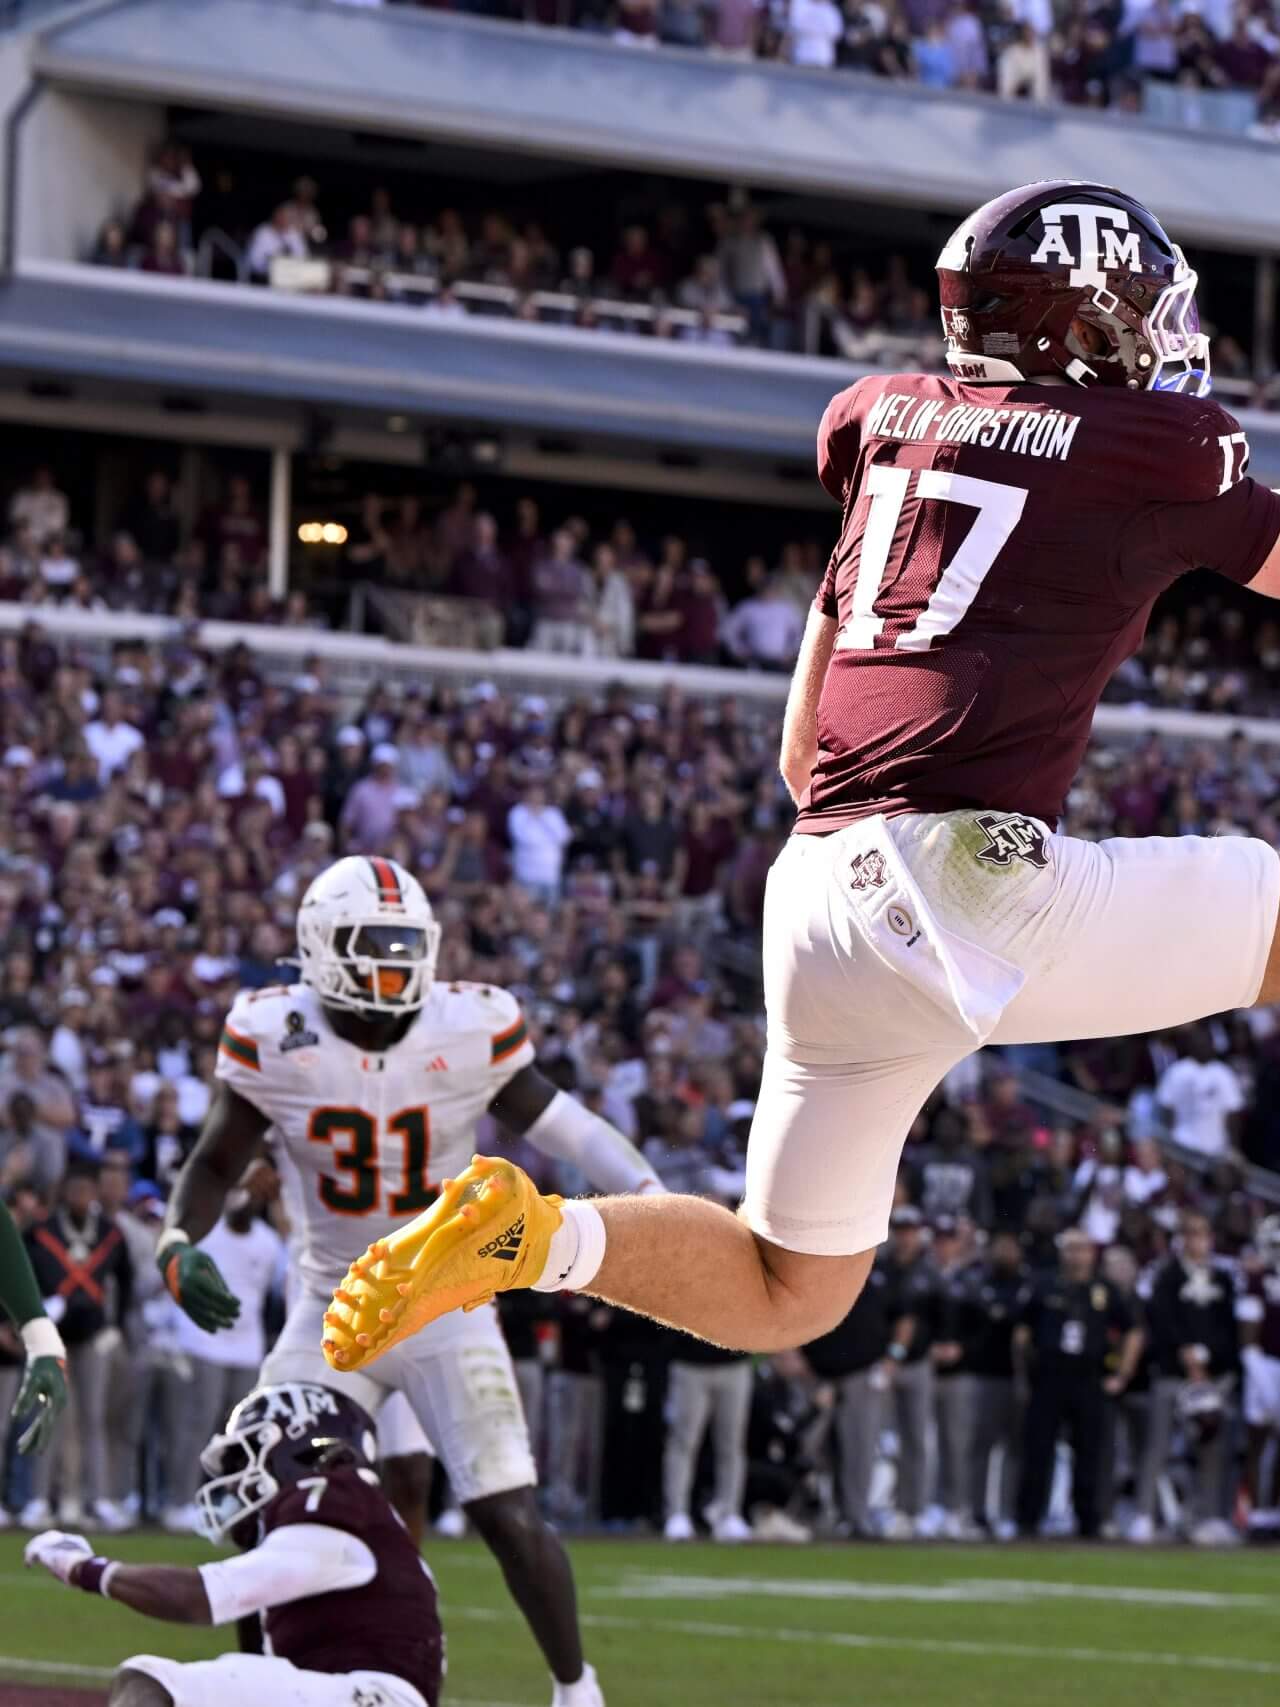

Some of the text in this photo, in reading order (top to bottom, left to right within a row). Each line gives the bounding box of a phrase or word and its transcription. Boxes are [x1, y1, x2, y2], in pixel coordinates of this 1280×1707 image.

[866, 391, 1081, 461] MELIN-ÖHRSTRÖM
[836, 464, 1029, 650] 17
[307, 1105, 441, 1217] 31
[477, 1212, 525, 1259] adidas
[296, 1477, 328, 1512] 7
